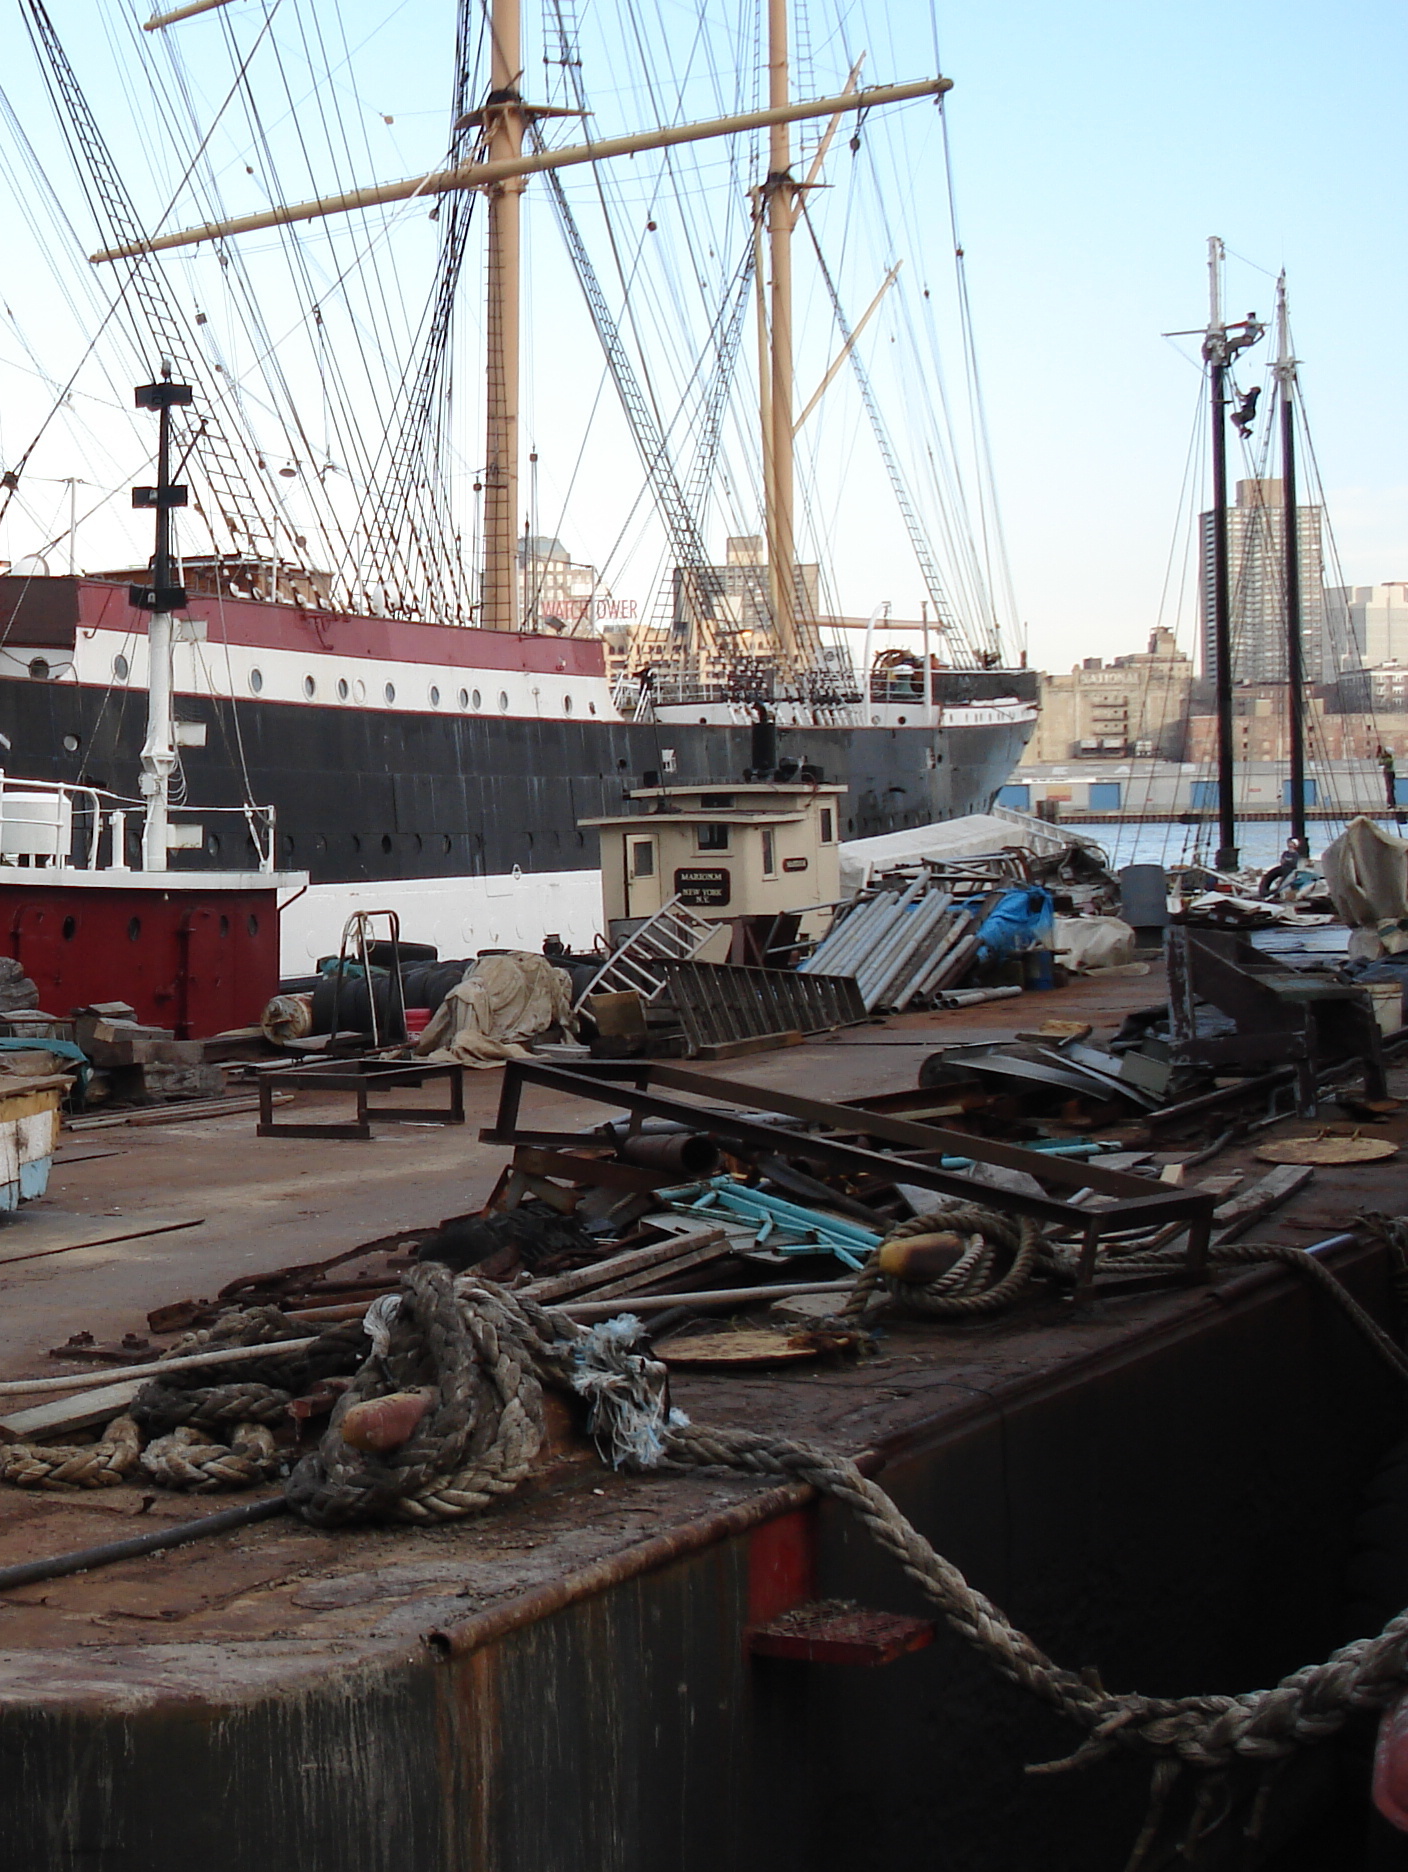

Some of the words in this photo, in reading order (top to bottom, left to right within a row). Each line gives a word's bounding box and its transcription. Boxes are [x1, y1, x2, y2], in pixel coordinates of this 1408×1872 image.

[541, 599, 638, 619] WATCHOWER
[682, 888, 700, 896] NEW
[701, 888, 722, 896] YORK
